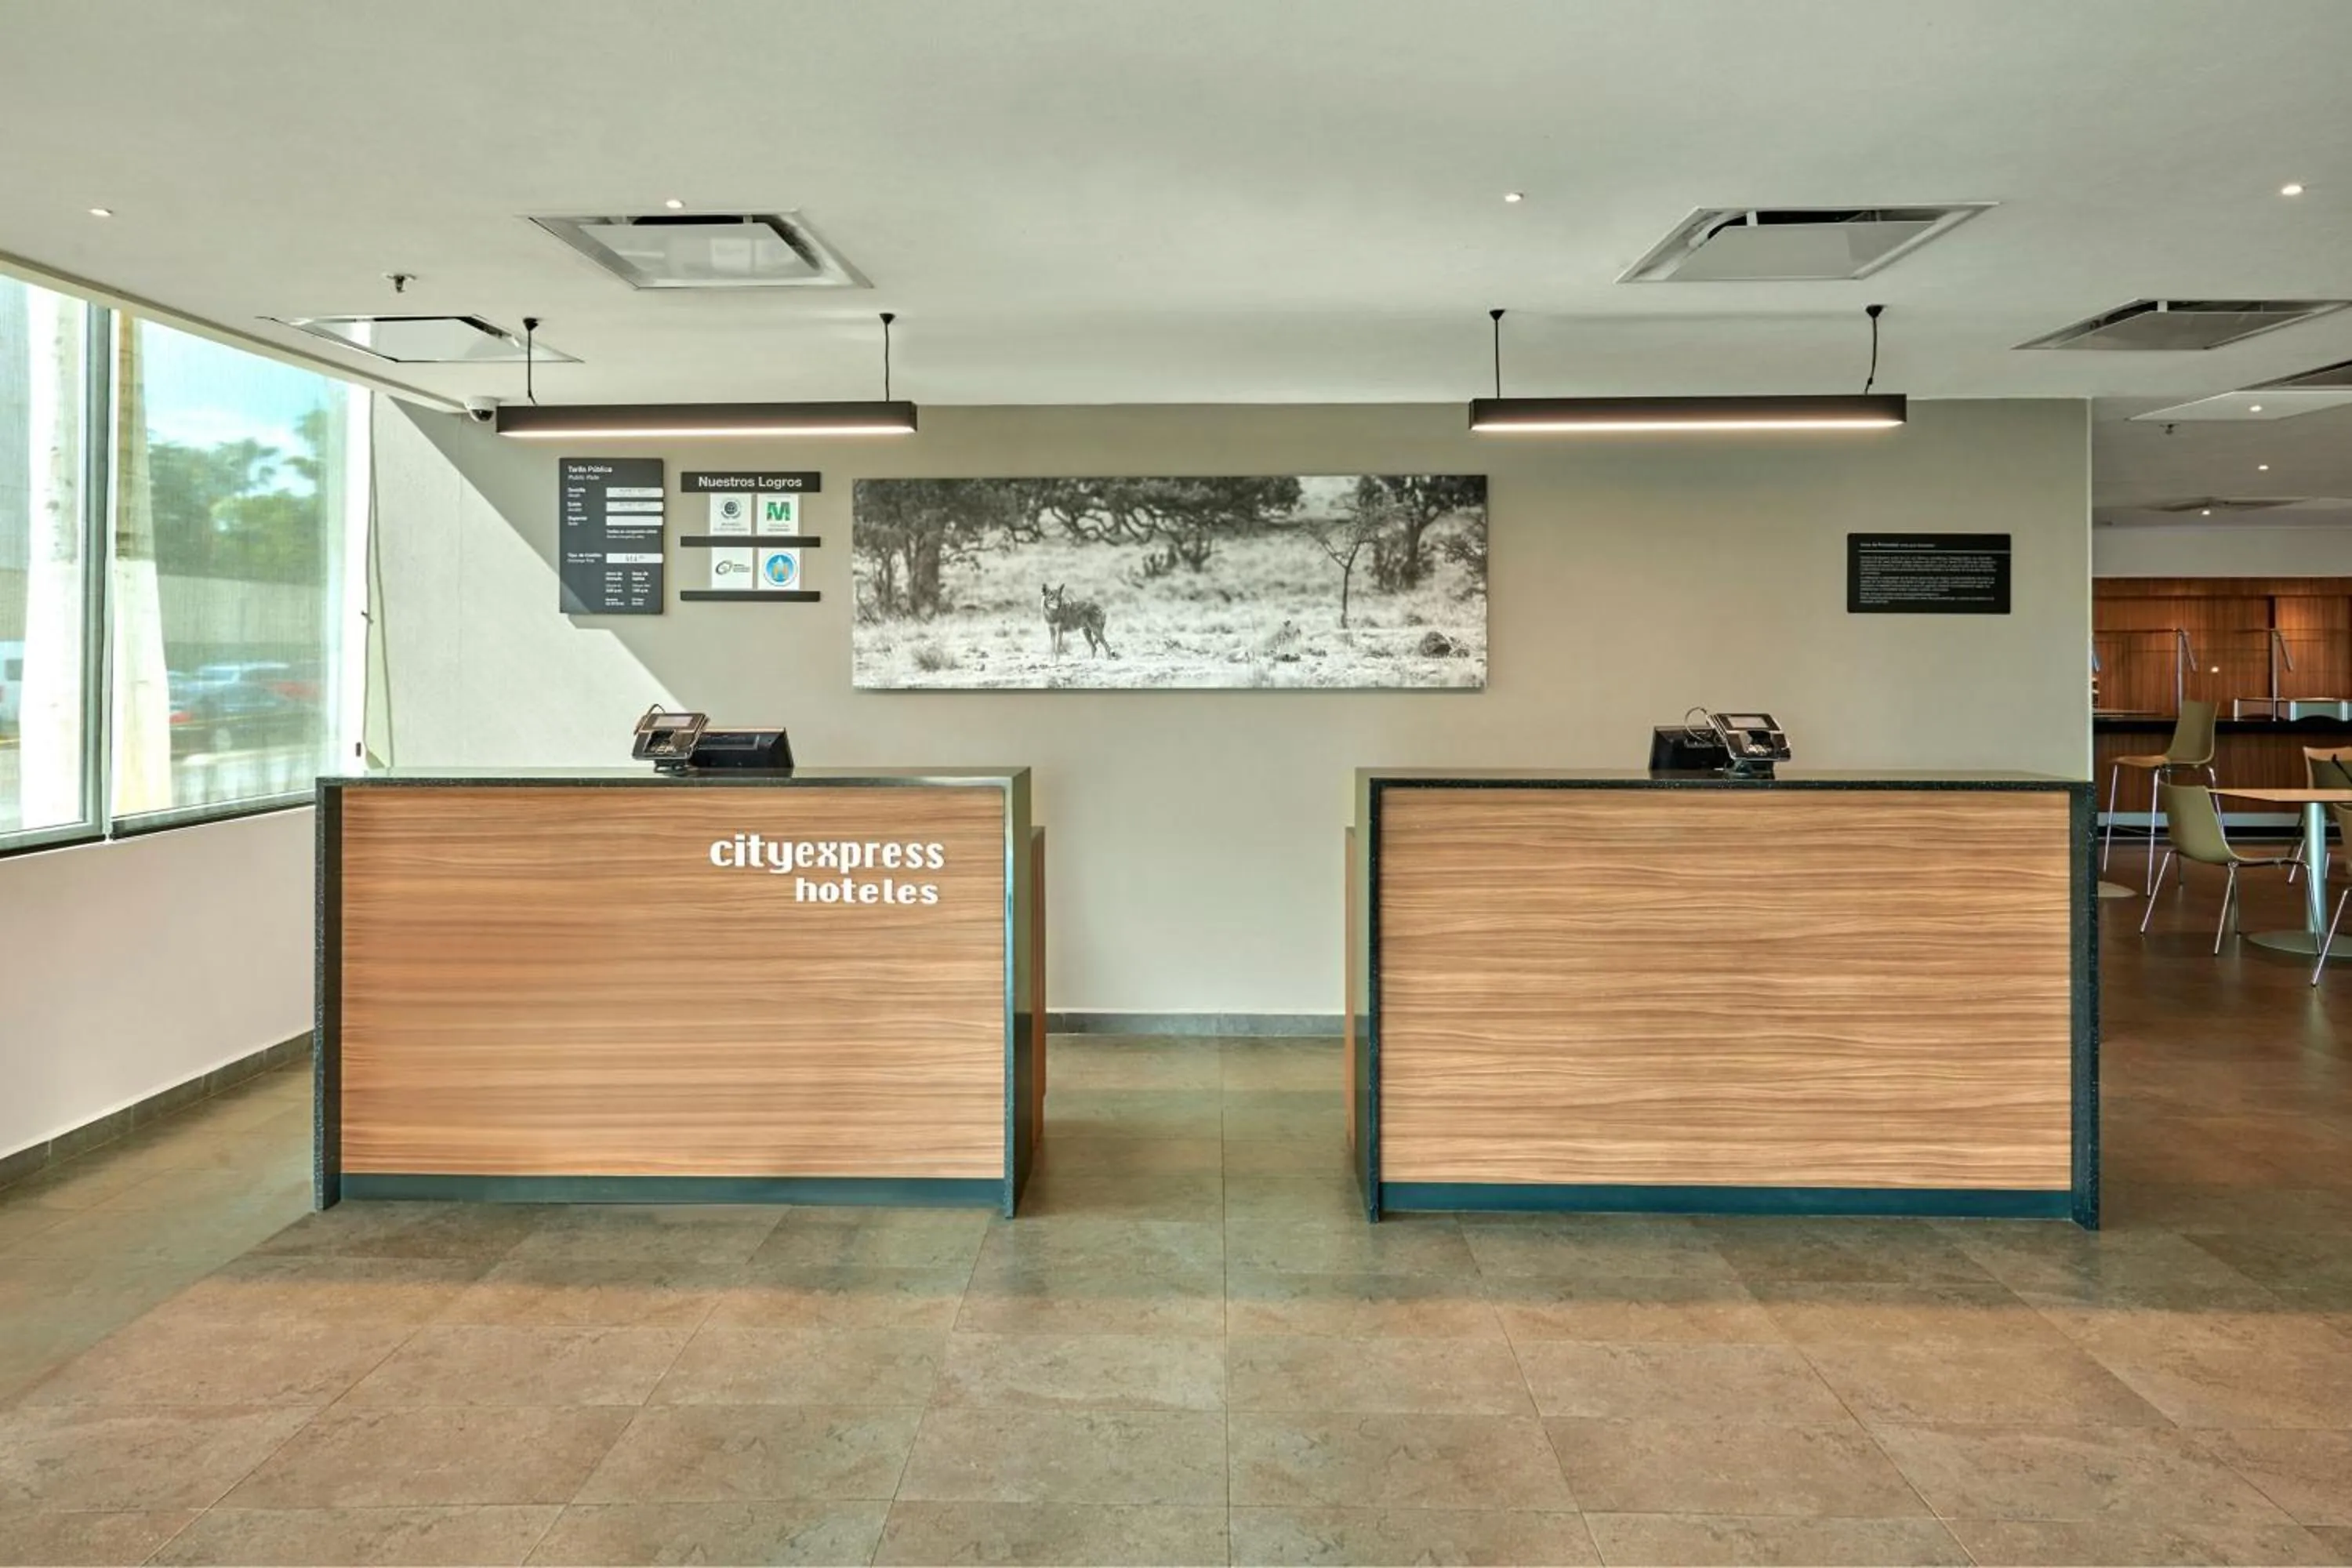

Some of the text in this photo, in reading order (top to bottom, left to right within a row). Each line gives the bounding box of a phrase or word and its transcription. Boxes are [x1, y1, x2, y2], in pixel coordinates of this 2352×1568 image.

[699, 476, 802, 490] Nuestros Logros
[709, 833, 946, 874] cityexpress
[795, 877, 939, 904] hoteles
